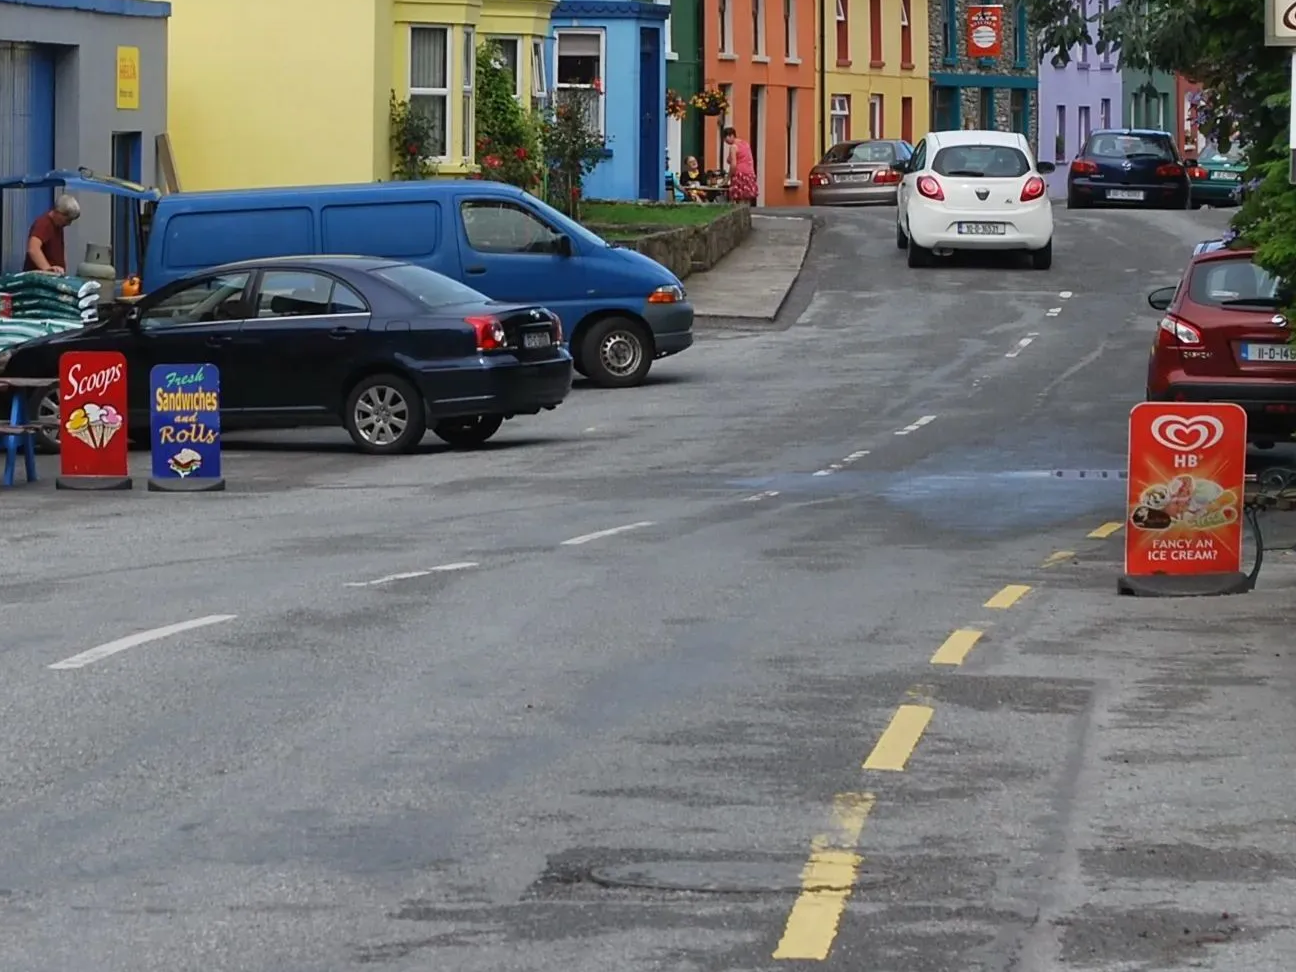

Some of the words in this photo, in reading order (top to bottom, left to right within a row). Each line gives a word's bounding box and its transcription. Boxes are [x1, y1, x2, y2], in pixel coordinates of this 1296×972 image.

[64, 363, 123, 401] Scoops
[165, 366, 205, 388] Fresh
[155, 387, 218, 412] Sandwiches
[174, 412, 197, 423] and
[159, 426, 219, 444] Rolls
[1174, 454, 1198, 468] HB
[1152, 539, 1192, 549] FANCY
[1195, 539, 1213, 548] AN
[1148, 550, 1167, 561] ICE
[1170, 550, 1218, 561] CREAM?
